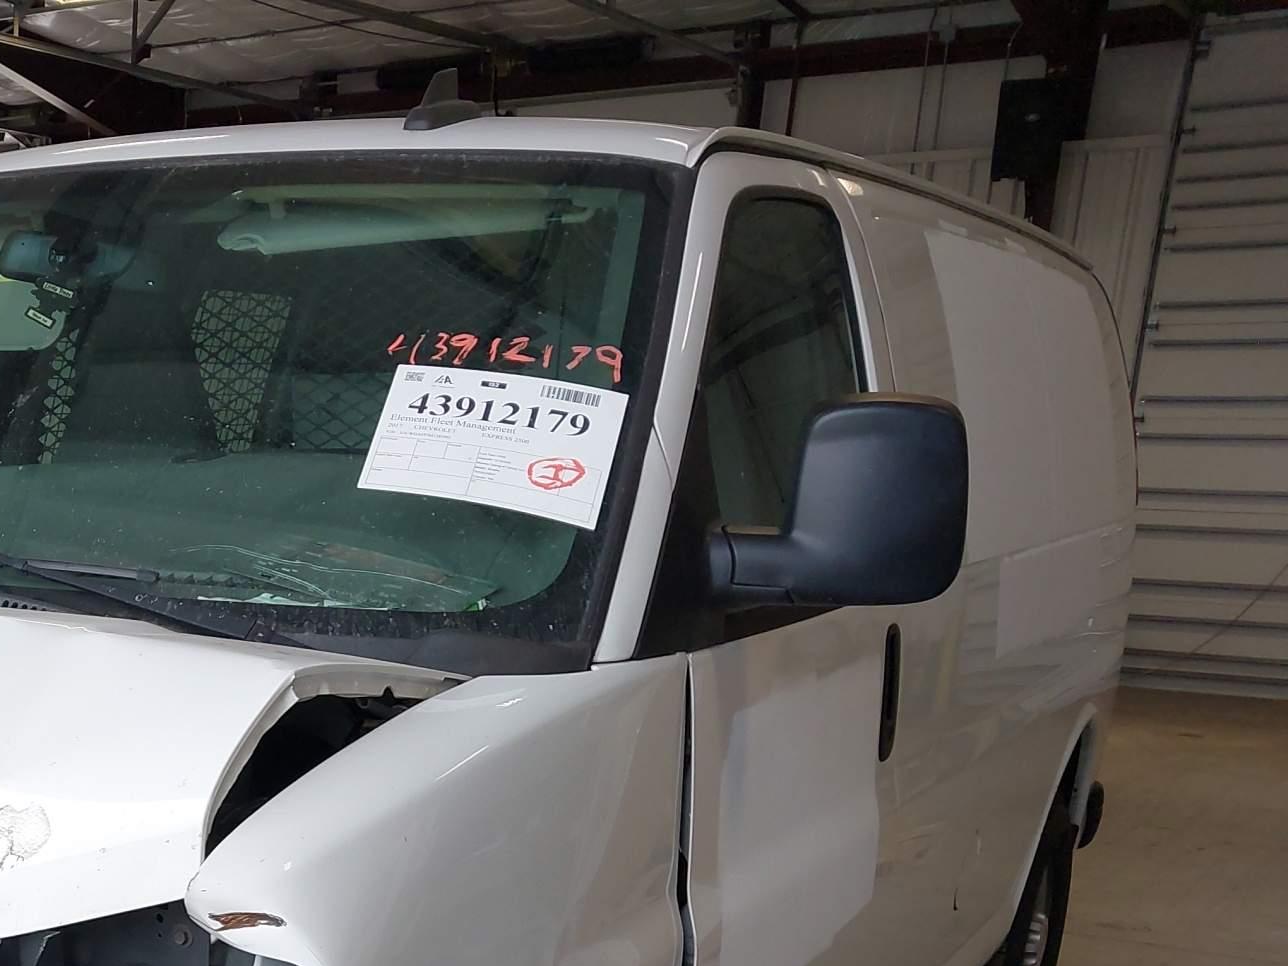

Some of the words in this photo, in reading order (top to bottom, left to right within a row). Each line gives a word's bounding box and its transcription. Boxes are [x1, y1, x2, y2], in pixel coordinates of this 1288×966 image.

[387, 332, 623, 384] 43912179
[391, 413, 429, 424] Element
[430, 415, 454, 426] Fleet
[456, 418, 517, 435] Management
[407, 392, 591, 437] 43912179
